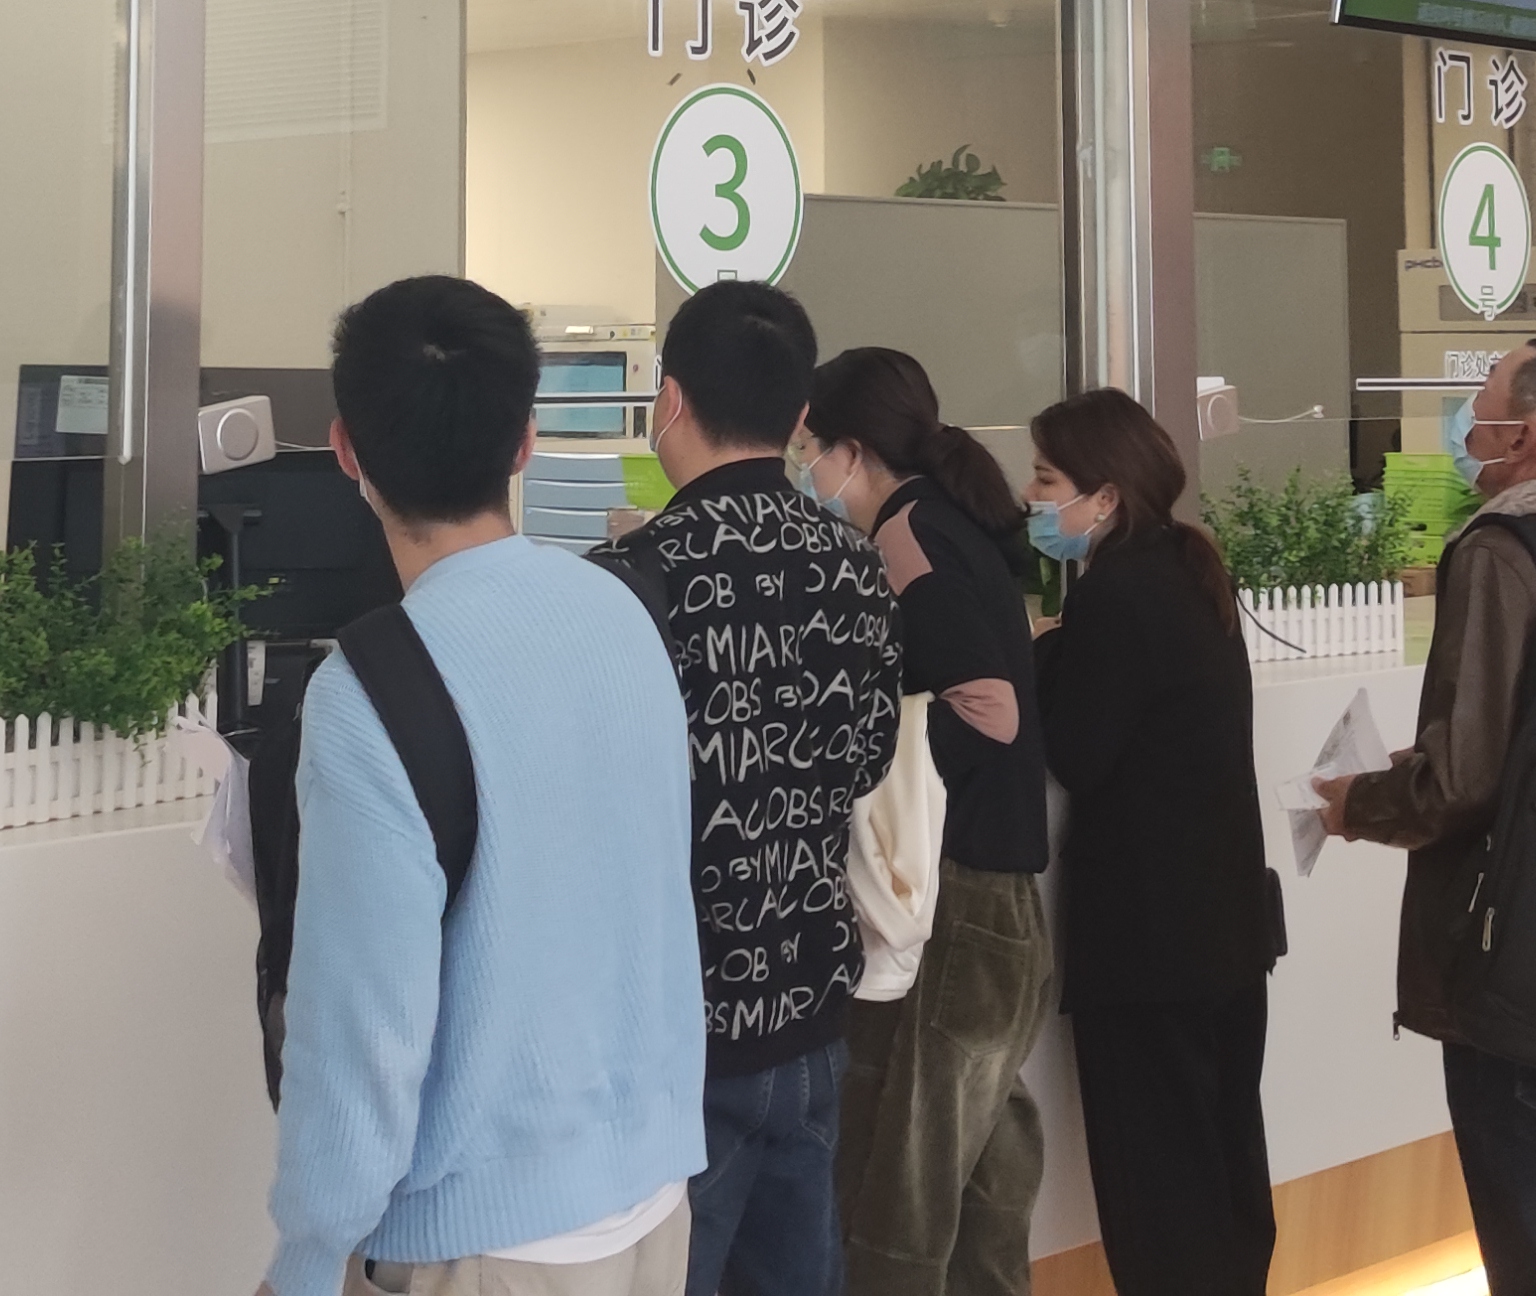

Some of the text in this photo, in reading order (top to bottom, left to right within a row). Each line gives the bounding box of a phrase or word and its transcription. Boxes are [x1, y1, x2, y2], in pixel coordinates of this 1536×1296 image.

[1434, 49, 1528, 128] 门诊
[698, 133, 752, 252] 3
[1468, 183, 1502, 271] 4
[1478, 285, 1497, 320] 号
